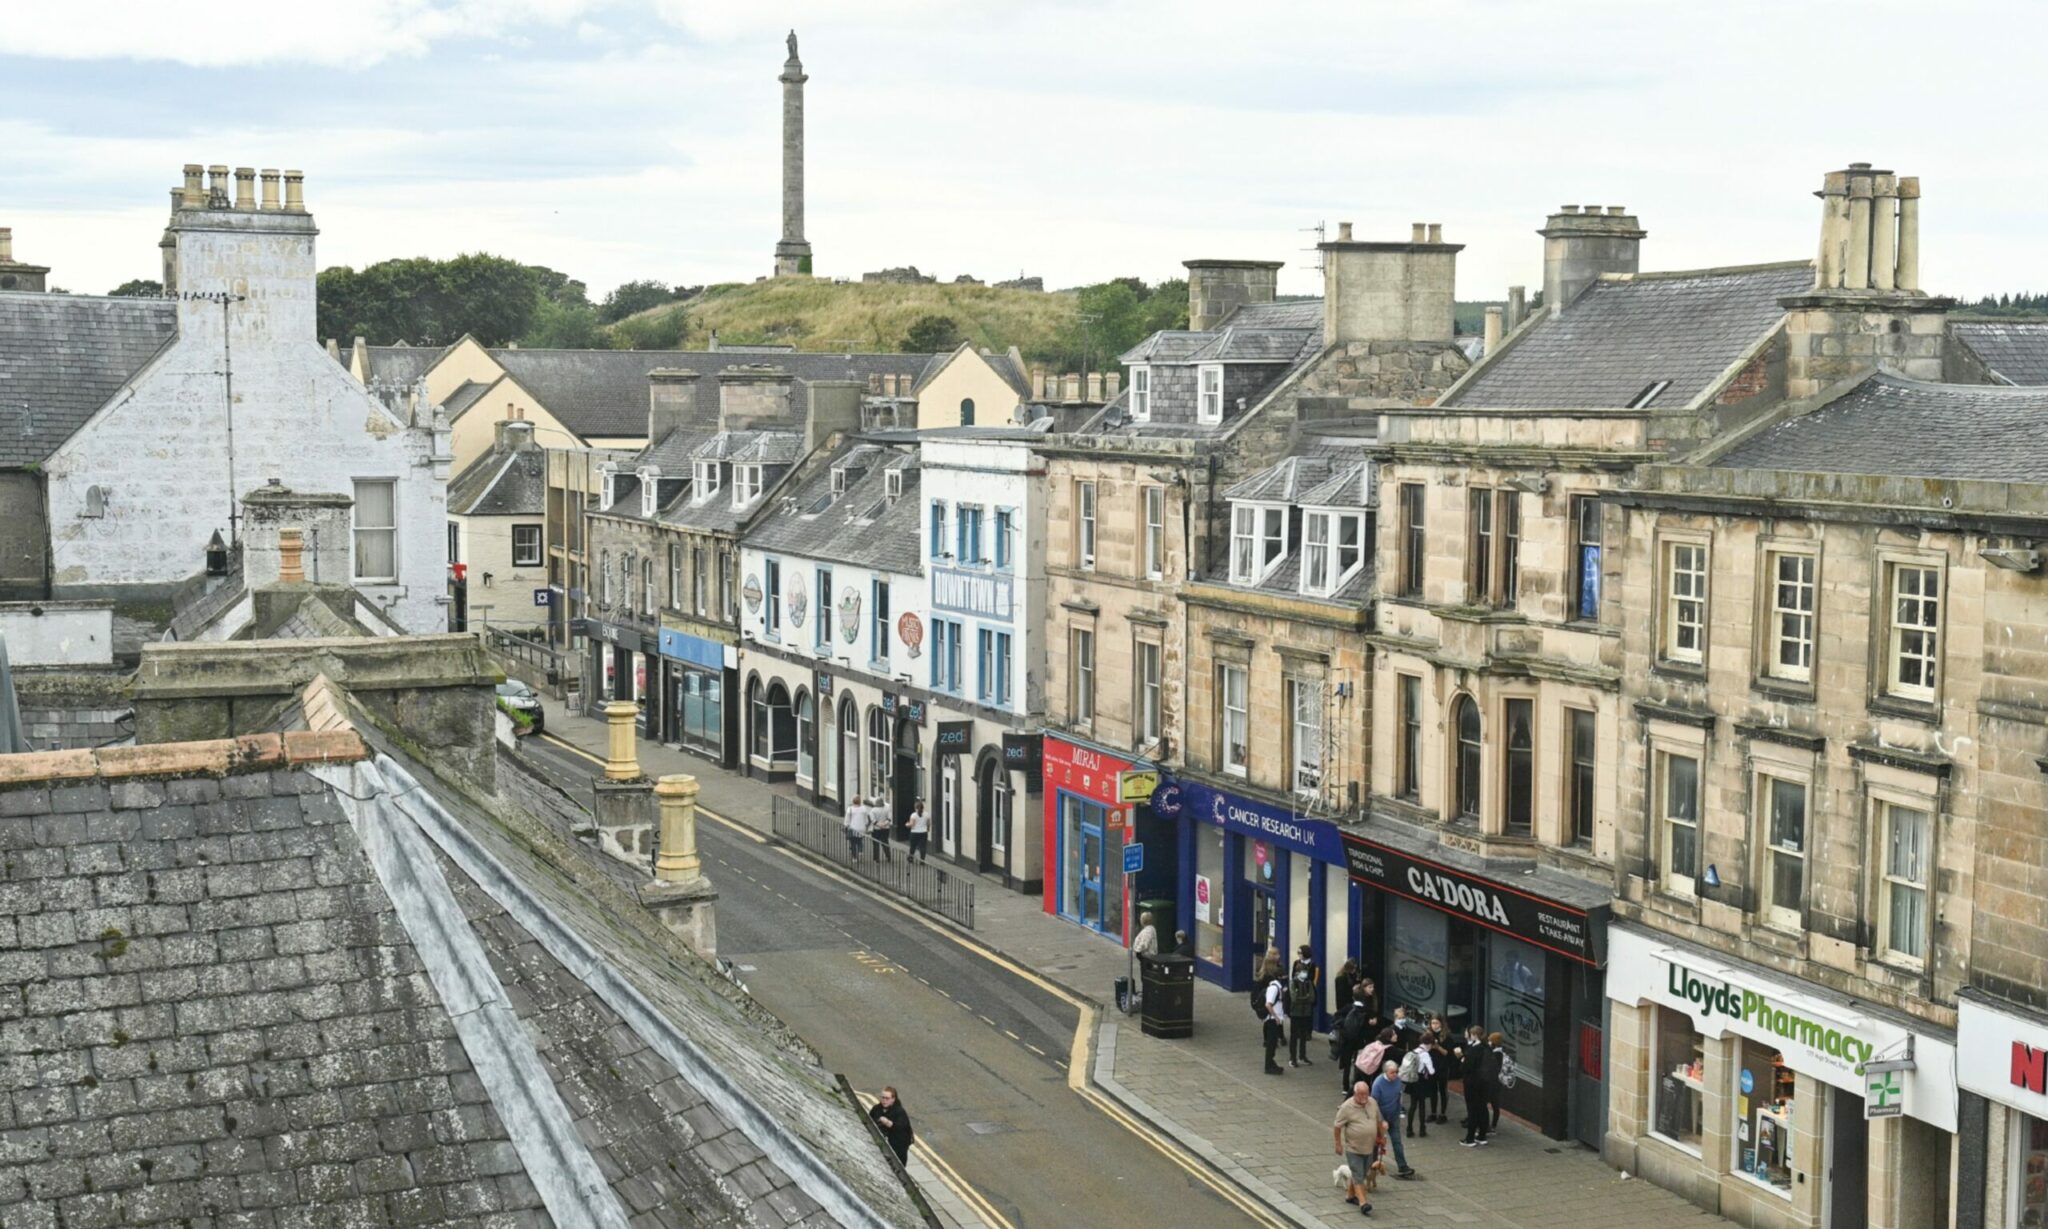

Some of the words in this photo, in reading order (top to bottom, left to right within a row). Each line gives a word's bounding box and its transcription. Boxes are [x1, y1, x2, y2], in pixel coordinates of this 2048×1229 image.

[935, 571, 994, 614] DOWNTOWN
[941, 730, 963, 743] zed
[1006, 746, 1023, 757] zed
[1072, 747, 1101, 771] MIRAJ
[1228, 806, 1259, 828] CANCER
[1261, 816, 1302, 842] RESEARCH
[1303, 829, 1315, 846] UK
[1407, 866, 1511, 926] CA'DORA
[1537, 912, 1580, 933] RESTAURANT
[1545, 926, 1584, 947] TAKE-AWAY
[1668, 962, 1874, 1077] LloydsPharmacy
[1869, 1106, 1900, 1115] Pharmacy
